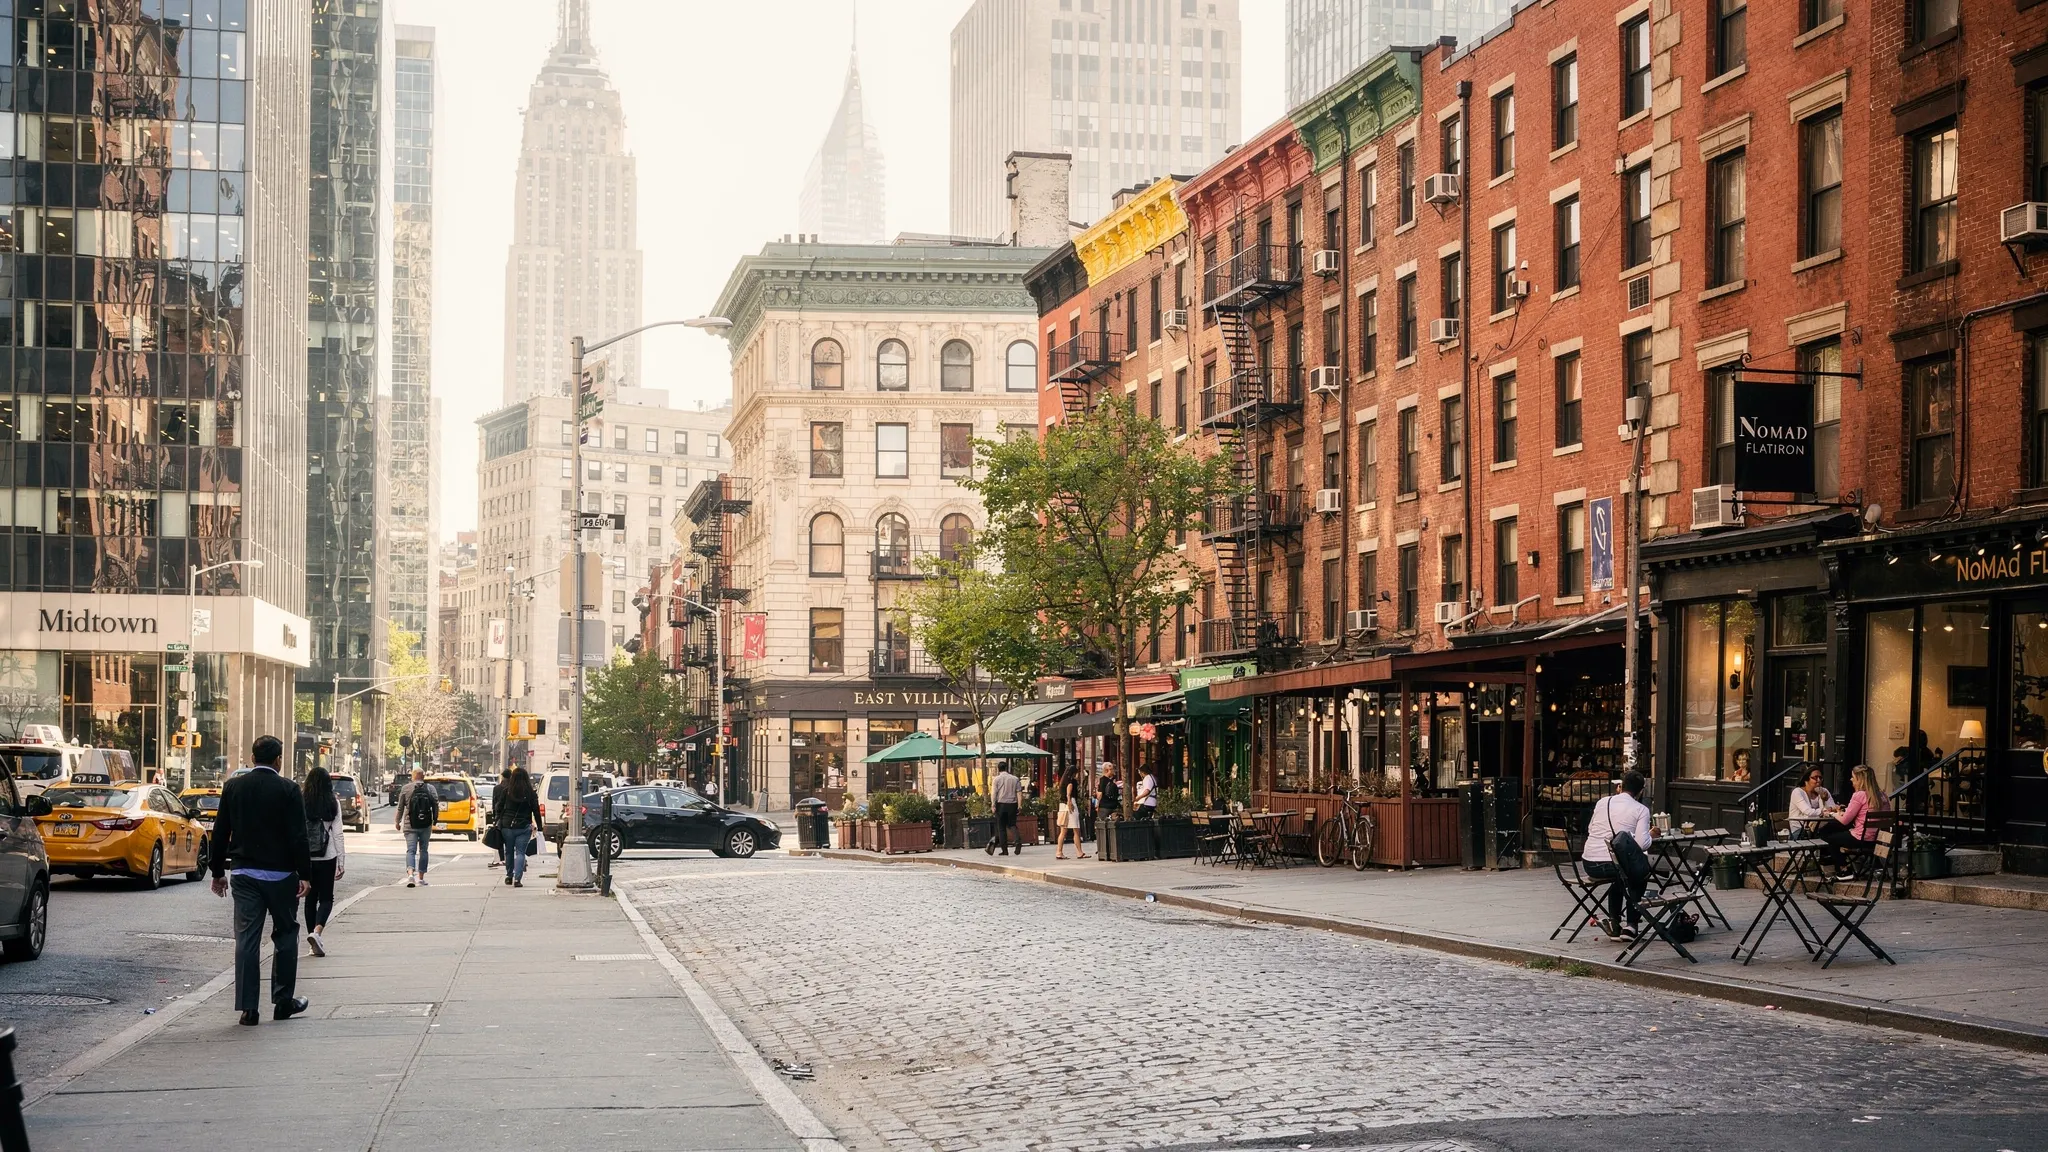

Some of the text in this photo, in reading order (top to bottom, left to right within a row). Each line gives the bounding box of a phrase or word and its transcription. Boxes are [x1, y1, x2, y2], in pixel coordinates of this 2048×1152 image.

[1738, 416, 1808, 440] NOMAD
[1746, 442, 1805, 455] FLATIRON
[1957, 551, 2020, 582] NoMAd
[38, 608, 158, 634] Midtown
[853, 691, 896, 705] EAST
